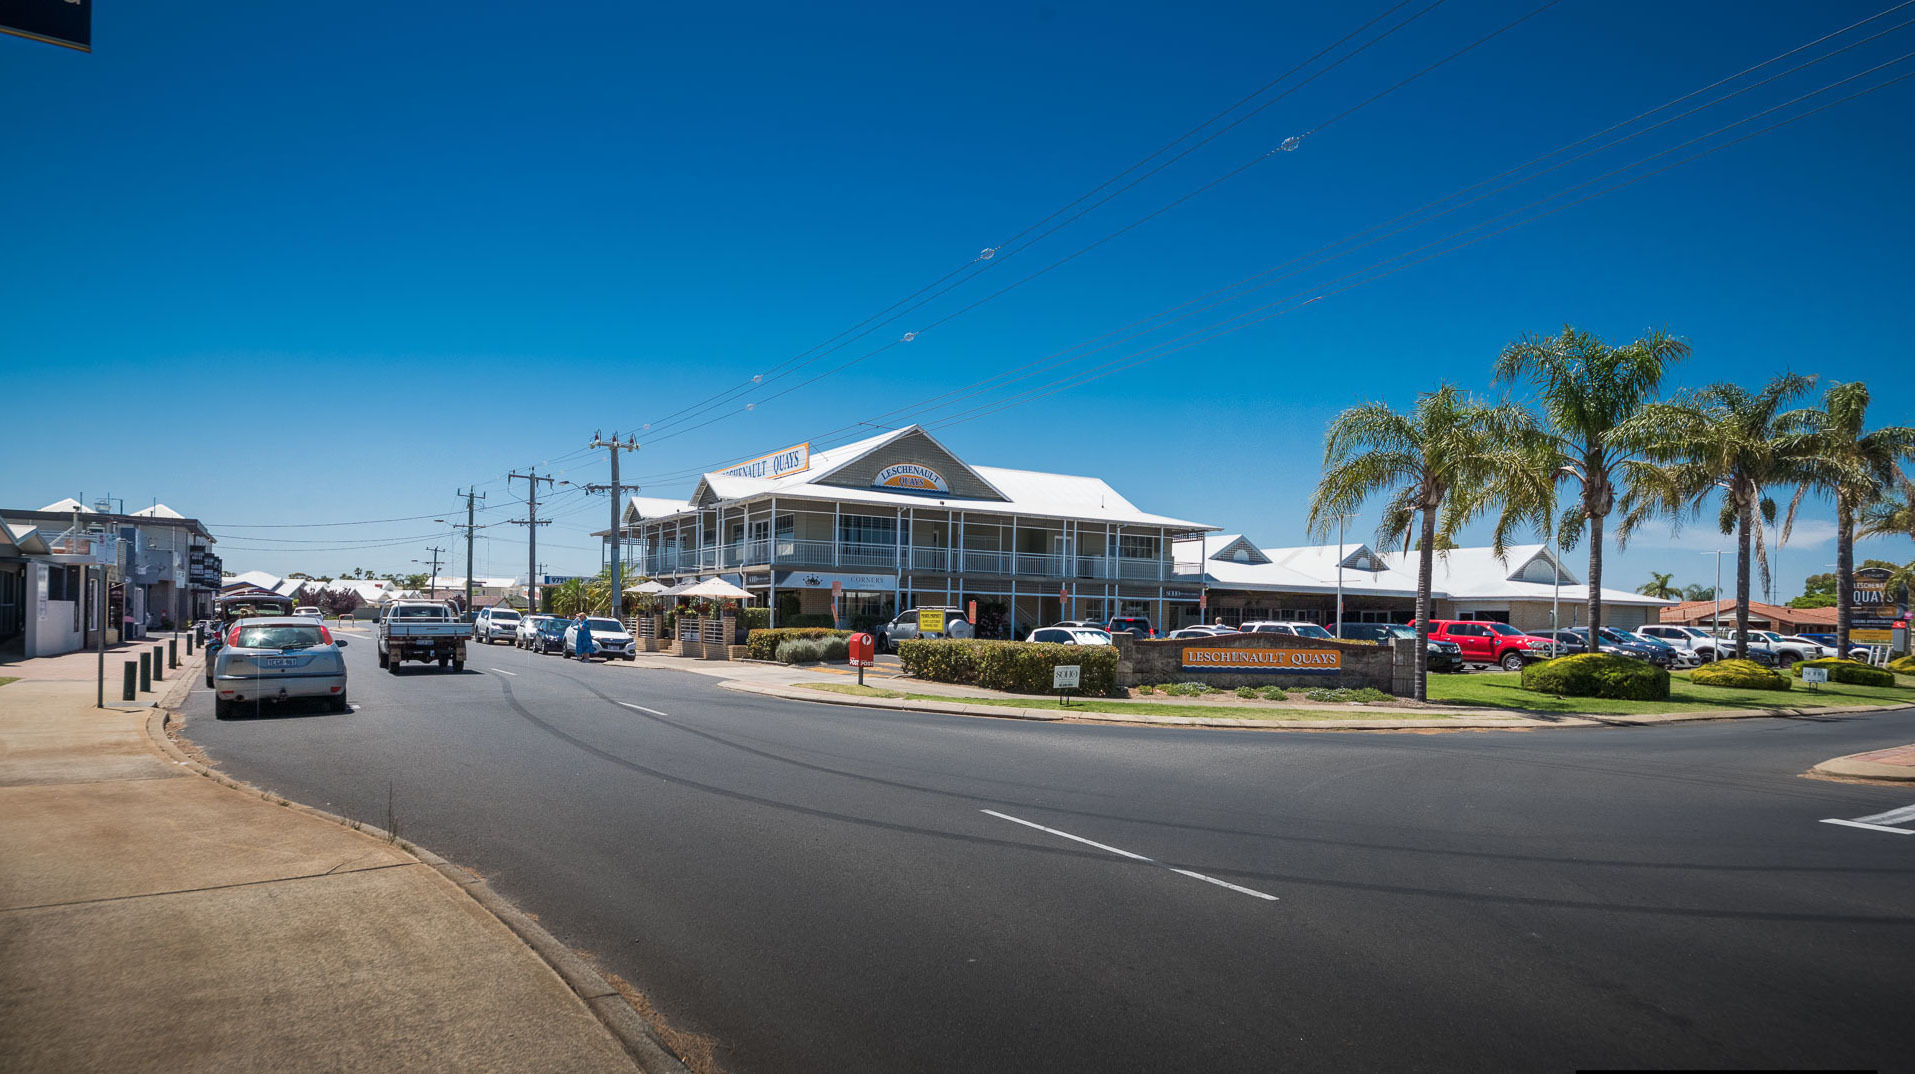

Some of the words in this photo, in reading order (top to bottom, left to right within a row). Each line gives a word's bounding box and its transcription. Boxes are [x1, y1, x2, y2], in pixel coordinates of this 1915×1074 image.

[773, 450, 799, 475] QUAYS
[881, 465, 940, 483] LESCHENAULT
[898, 476, 924, 487] QUAYS
[850, 575, 884, 584] CORNERS
[1853, 590, 1894, 605] QUAYS
[1188, 651, 1286, 664] LESCHENAULT
[1290, 653, 1337, 665] QUAYS
